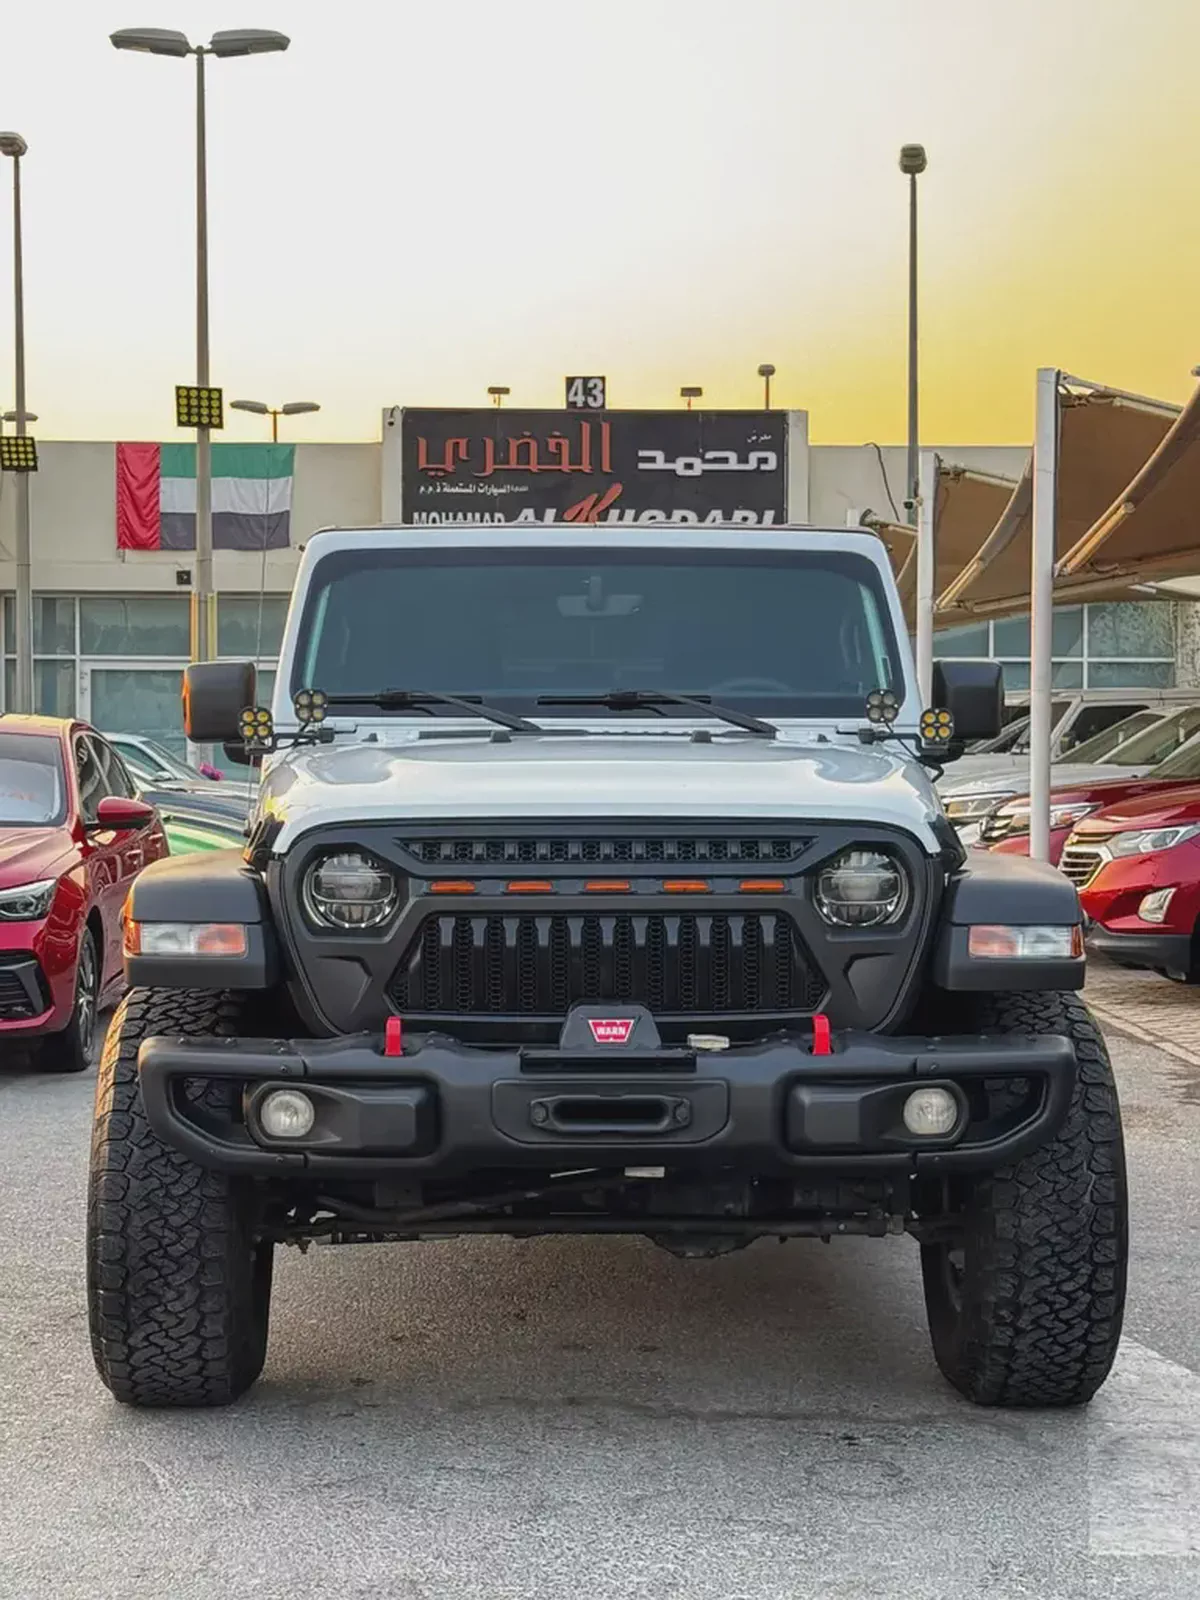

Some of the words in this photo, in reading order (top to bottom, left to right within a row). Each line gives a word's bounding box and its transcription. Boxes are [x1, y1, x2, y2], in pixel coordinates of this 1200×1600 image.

[568, 378, 604, 408] 43
[416, 420, 615, 478] الخضري
[637, 450, 778, 477] محمد
[596, 1026, 626, 1036] WARN
